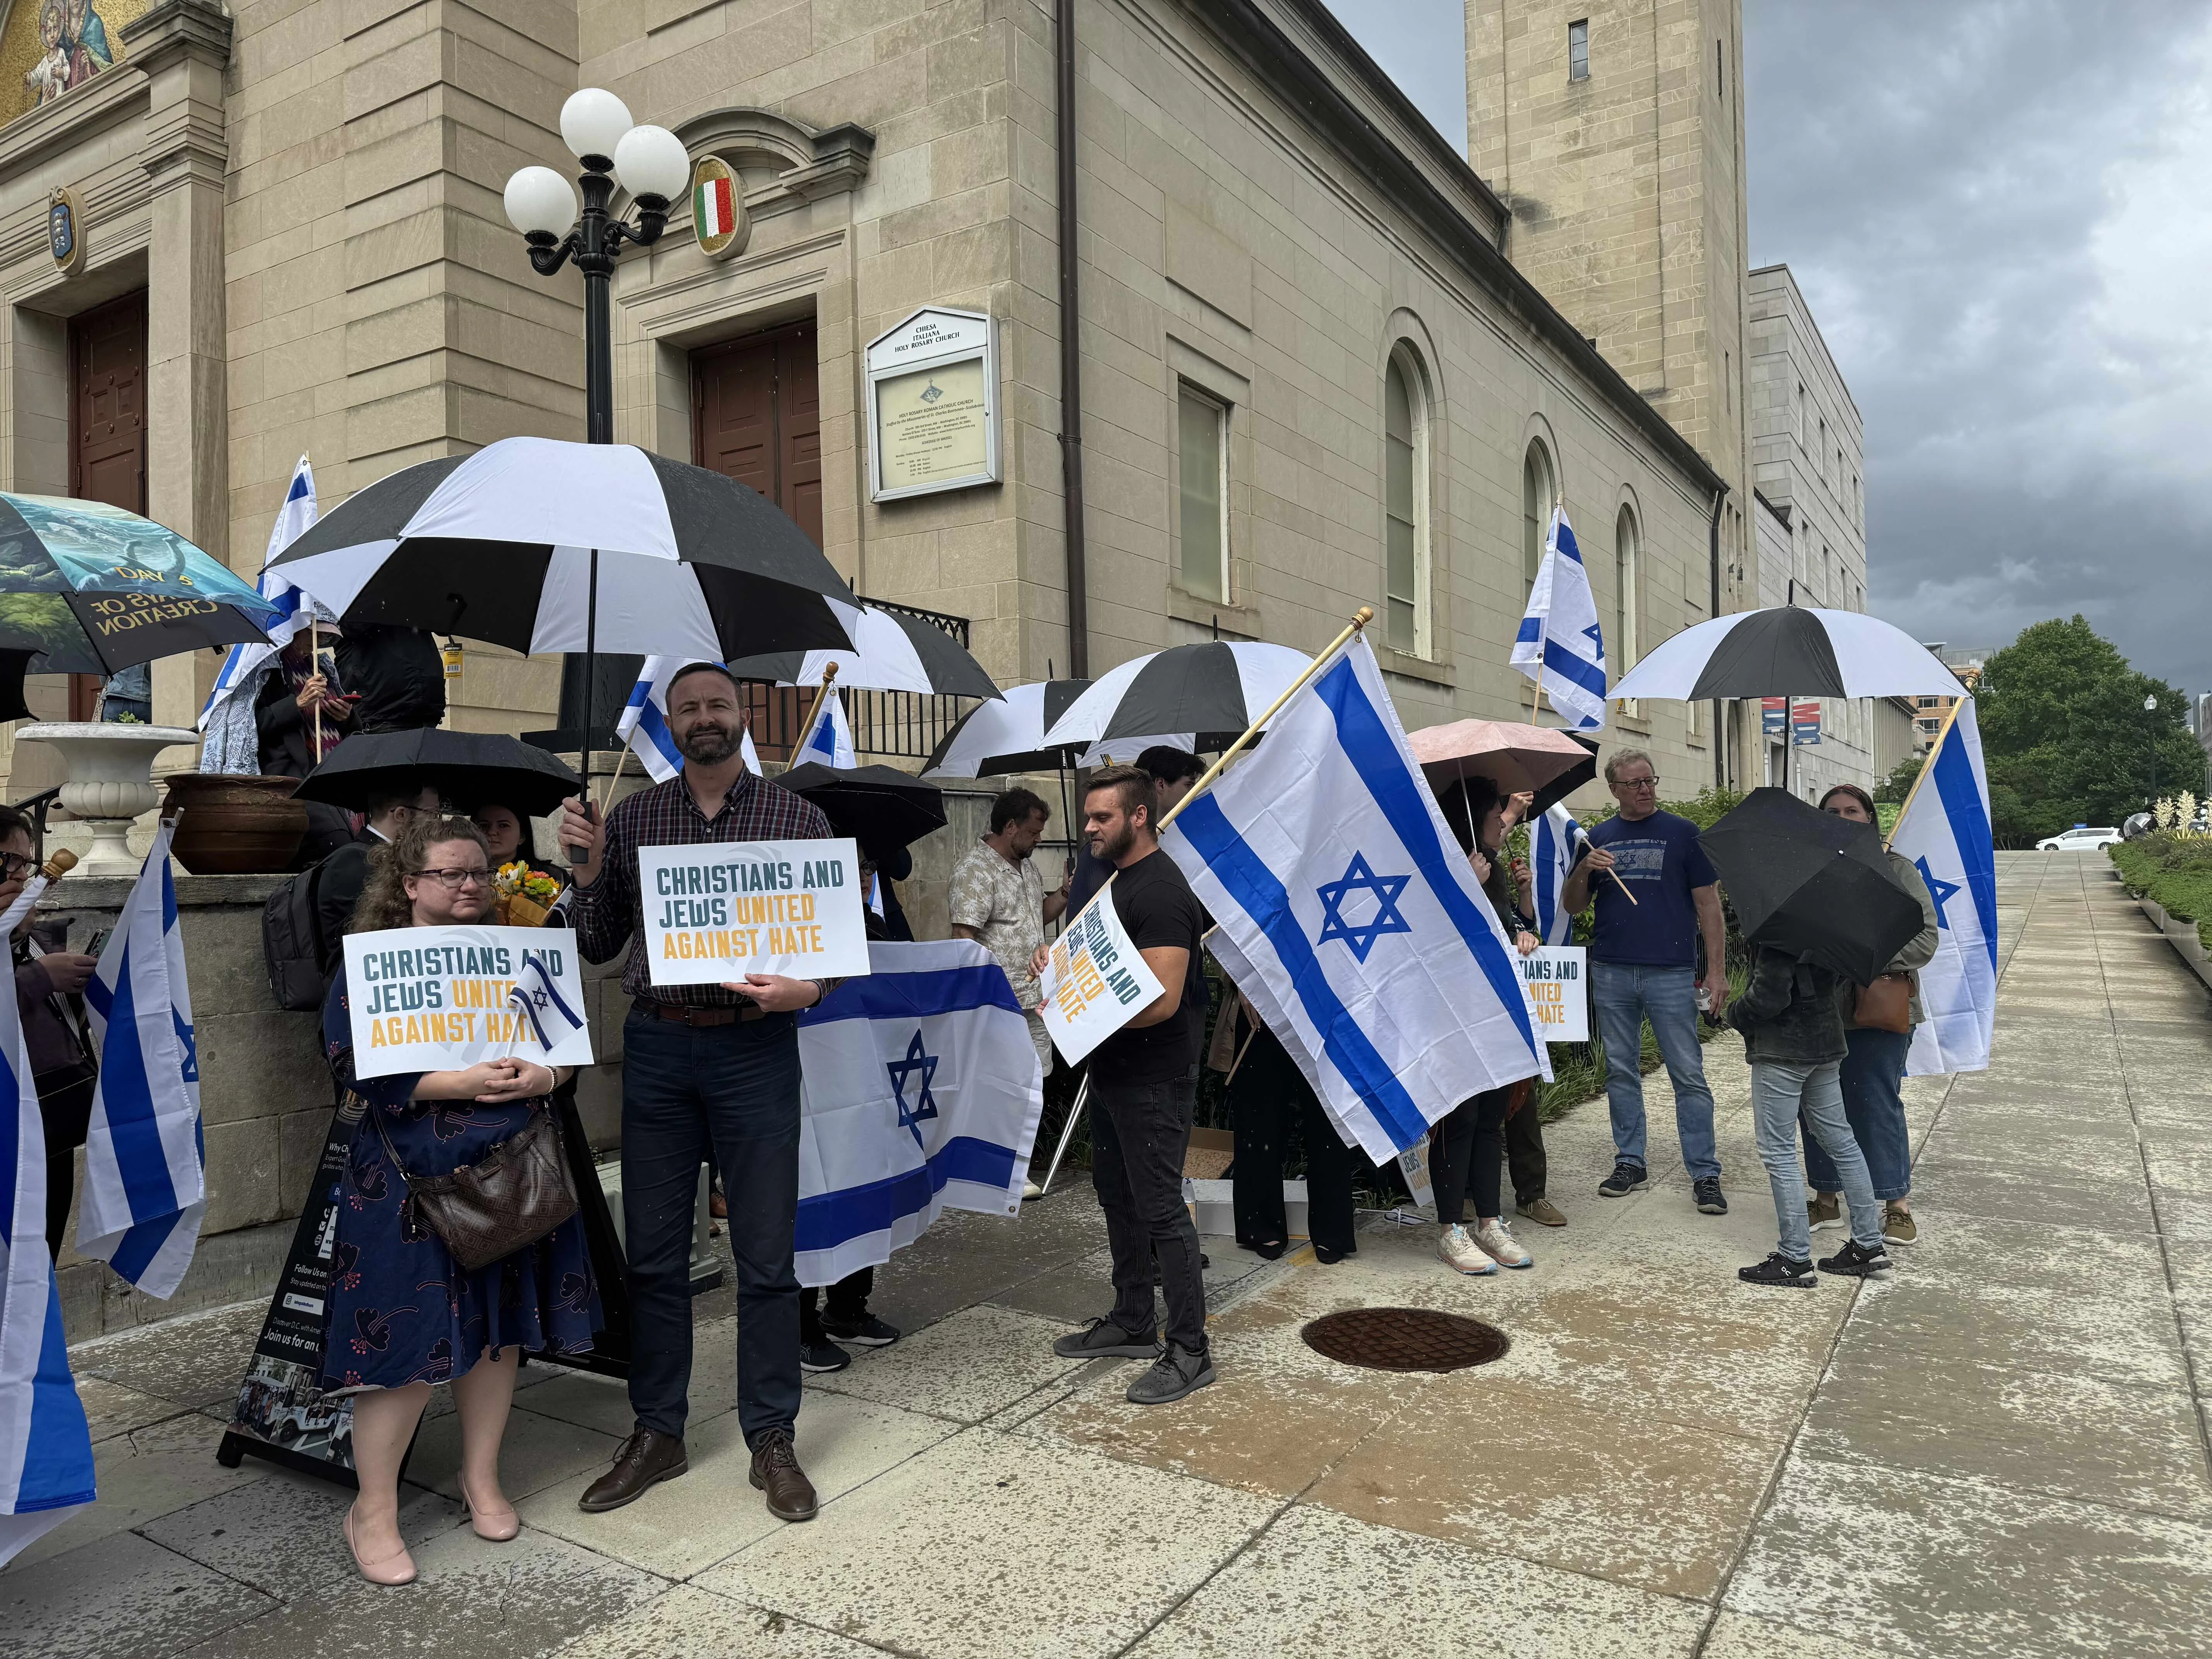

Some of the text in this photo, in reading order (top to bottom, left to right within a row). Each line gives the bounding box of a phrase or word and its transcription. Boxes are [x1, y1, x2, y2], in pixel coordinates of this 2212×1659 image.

[913, 330, 940, 341] ITALIANA
[916, 324, 936, 333] CHIESA
[895, 332, 959, 352] HOLY ROSARY CHURCH
[114, 566, 193, 586] DAY 5
[656, 860, 844, 895] CHRISTIANS AND
[659, 893, 815, 929] JEWS UNITED
[664, 925, 825, 960] AGAINST HATE
[1067, 921, 1105, 1002] JEWS UNITED
[1084, 901, 1141, 1006] CHRISTIANS AND
[363, 947, 511, 981] CHRISTIANS
[1556, 961, 1578, 980] AND
[366, 980, 442, 1014] JEWS
[1056, 978, 1087, 1024] HATE
[1528, 982, 1561, 1001] NITED
[1537, 1004, 1565, 1023] HATE
[371, 1013, 476, 1048] AGAINST
[329, 1142, 341, 1153] Why
[1403, 1152, 1420, 1173] JEWS
[294, 1264, 313, 1275] Follow
[313, 1267, 319, 1276] Us
[290, 1277, 299, 1286] Stay
[300, 1280, 316, 1288] updated
[273, 1317, 291, 1327] Discover
[309, 1326, 321, 1334] Amer
[264, 1328, 282, 1342] Join
[282, 1335, 291, 1345] us
[292, 1334, 305, 1347] for
[304, 1340, 315, 1351] an
